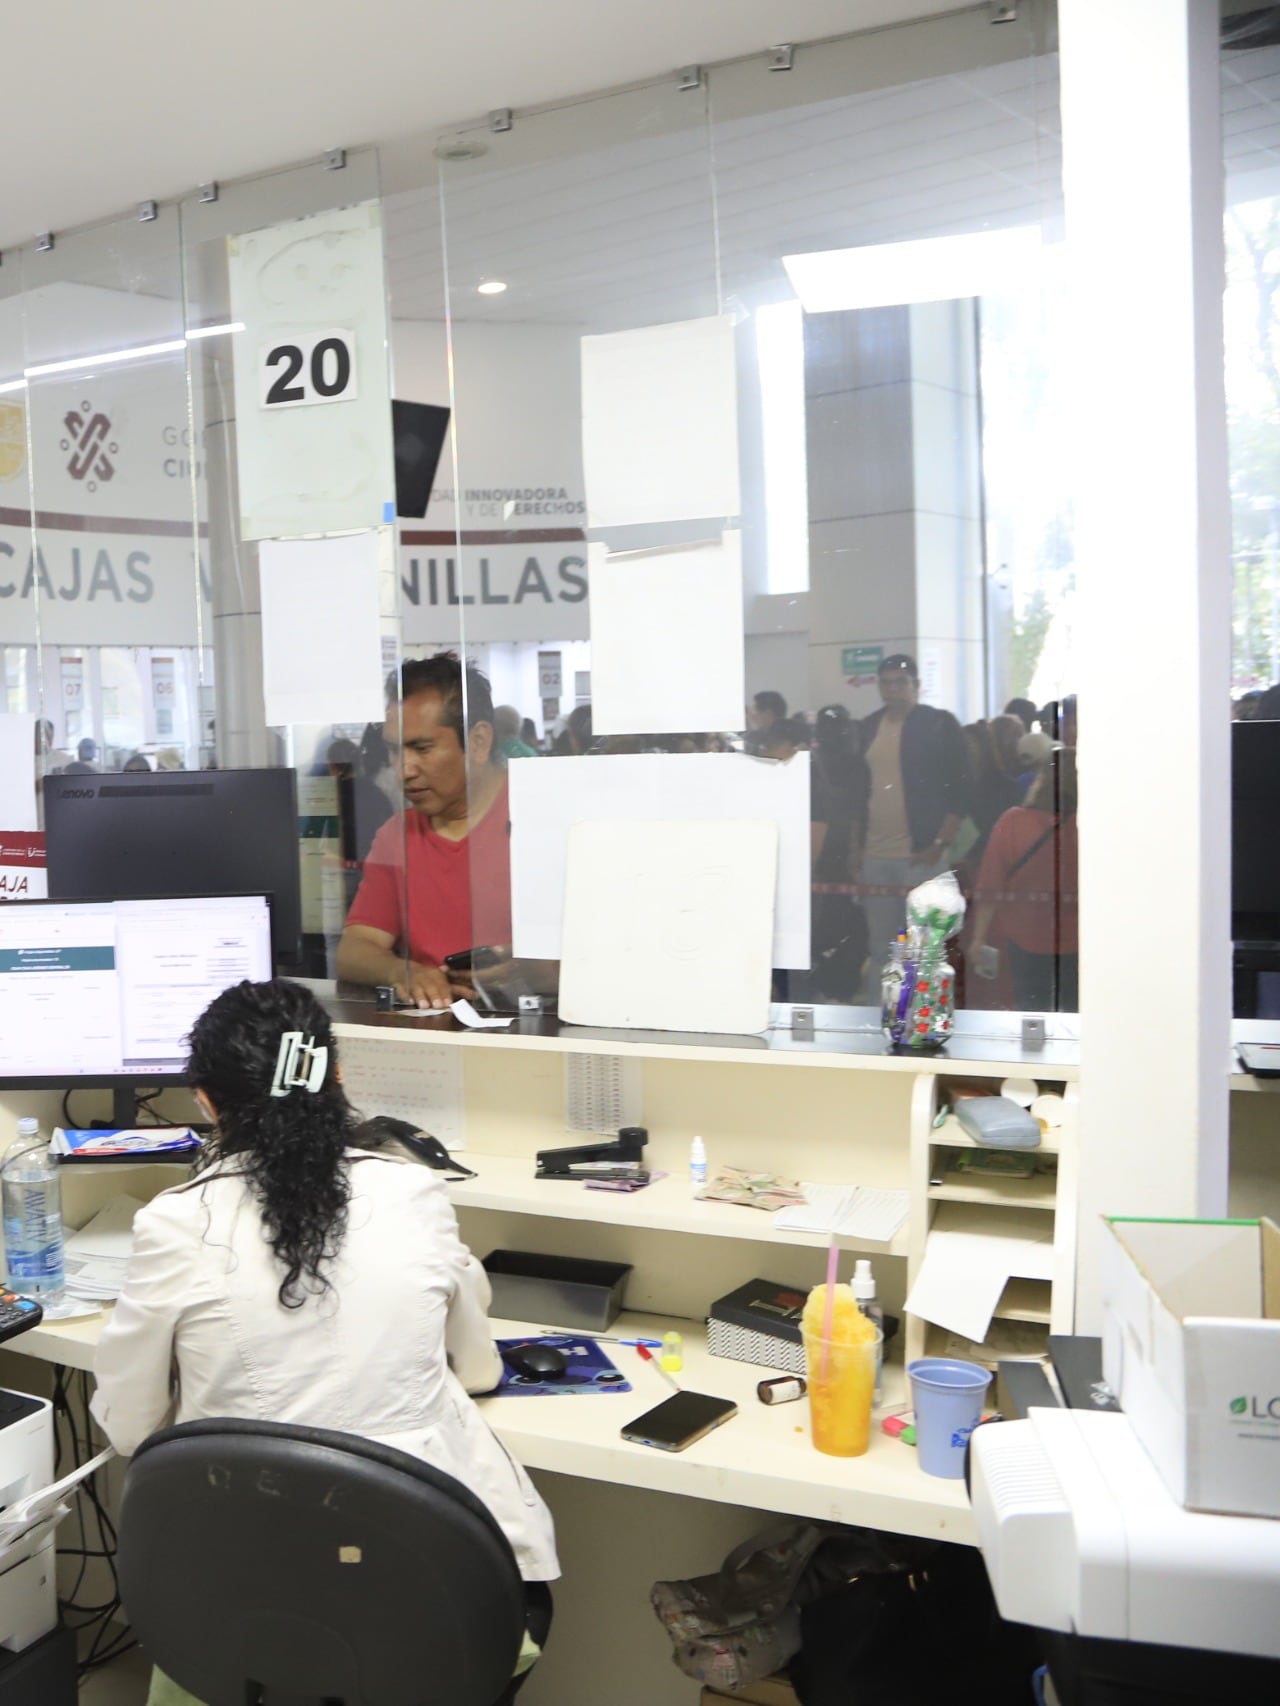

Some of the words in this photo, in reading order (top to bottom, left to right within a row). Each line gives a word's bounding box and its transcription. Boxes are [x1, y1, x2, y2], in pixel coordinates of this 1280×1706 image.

[265, 337, 351, 404] 20
[465, 487, 568, 501] INNOVADORA
[514, 500, 587, 515] ERECHOS
